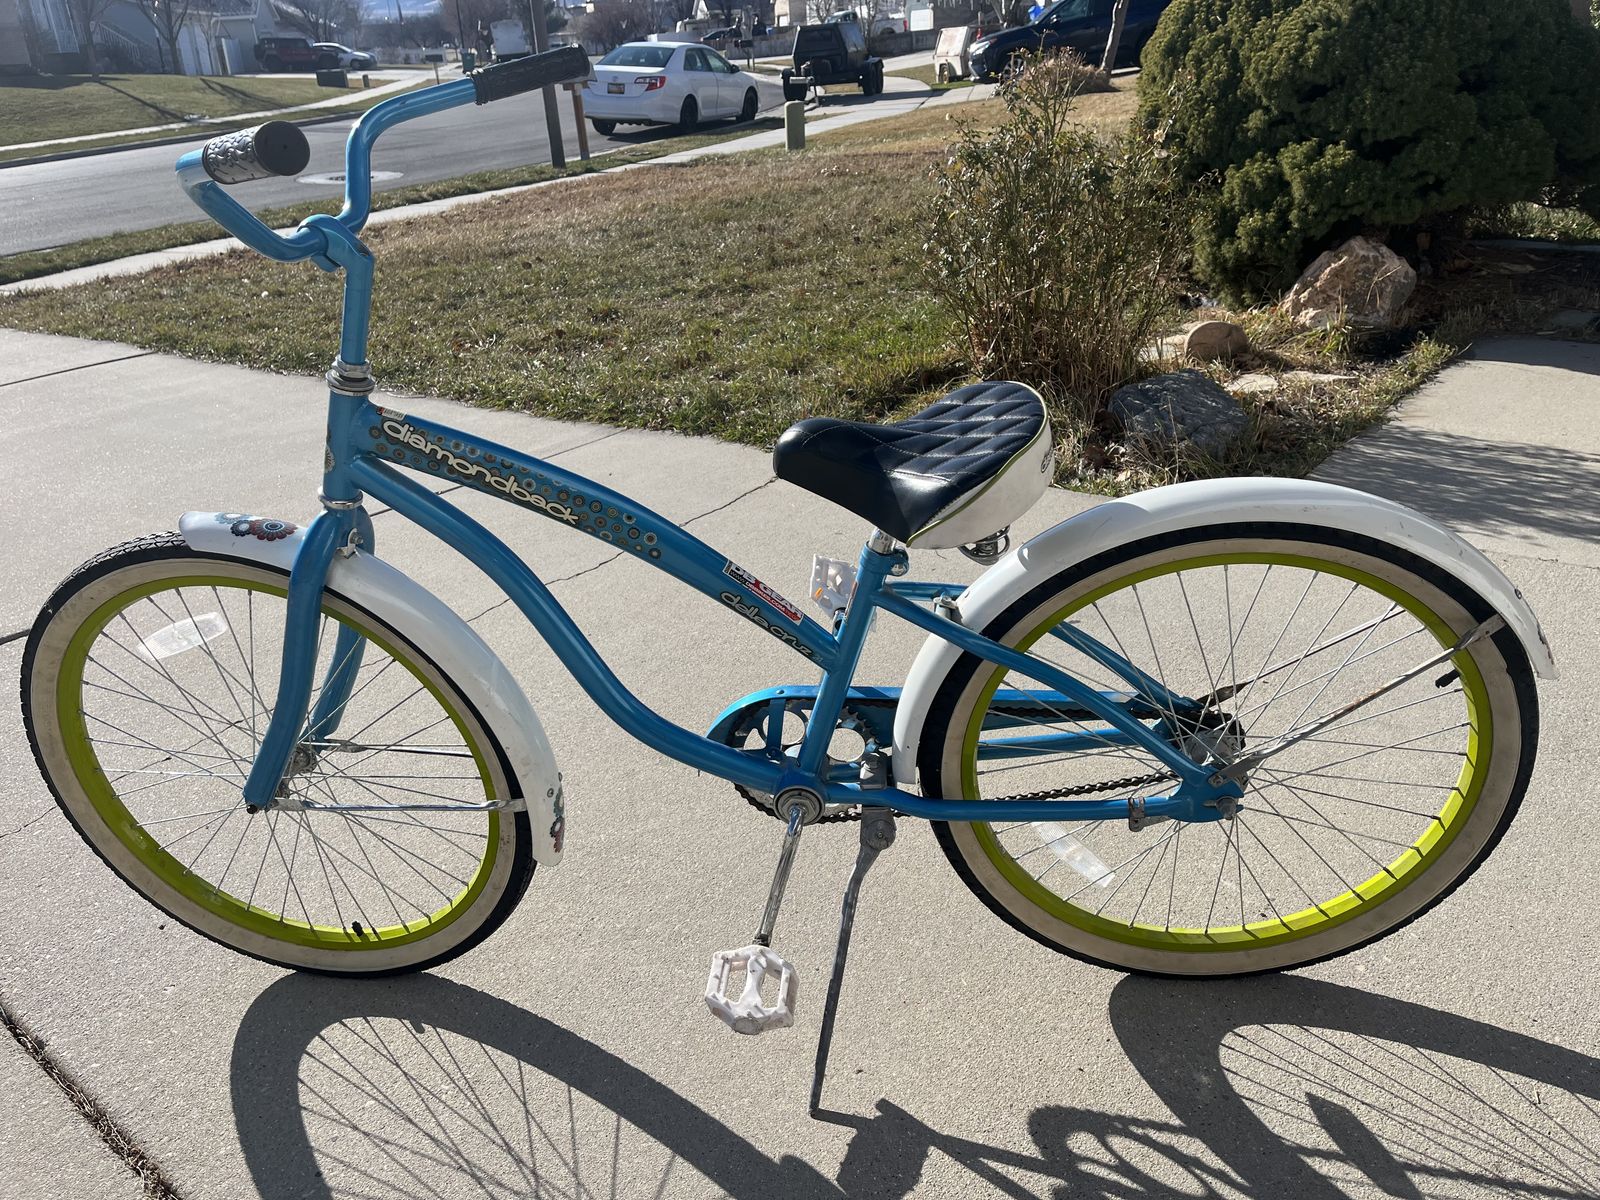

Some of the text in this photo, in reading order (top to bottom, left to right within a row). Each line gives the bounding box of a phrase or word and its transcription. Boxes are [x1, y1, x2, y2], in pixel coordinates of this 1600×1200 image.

[382, 420, 579, 525] diamondback
[729, 561, 757, 584] DB
[758, 580, 802, 617] GEAR
